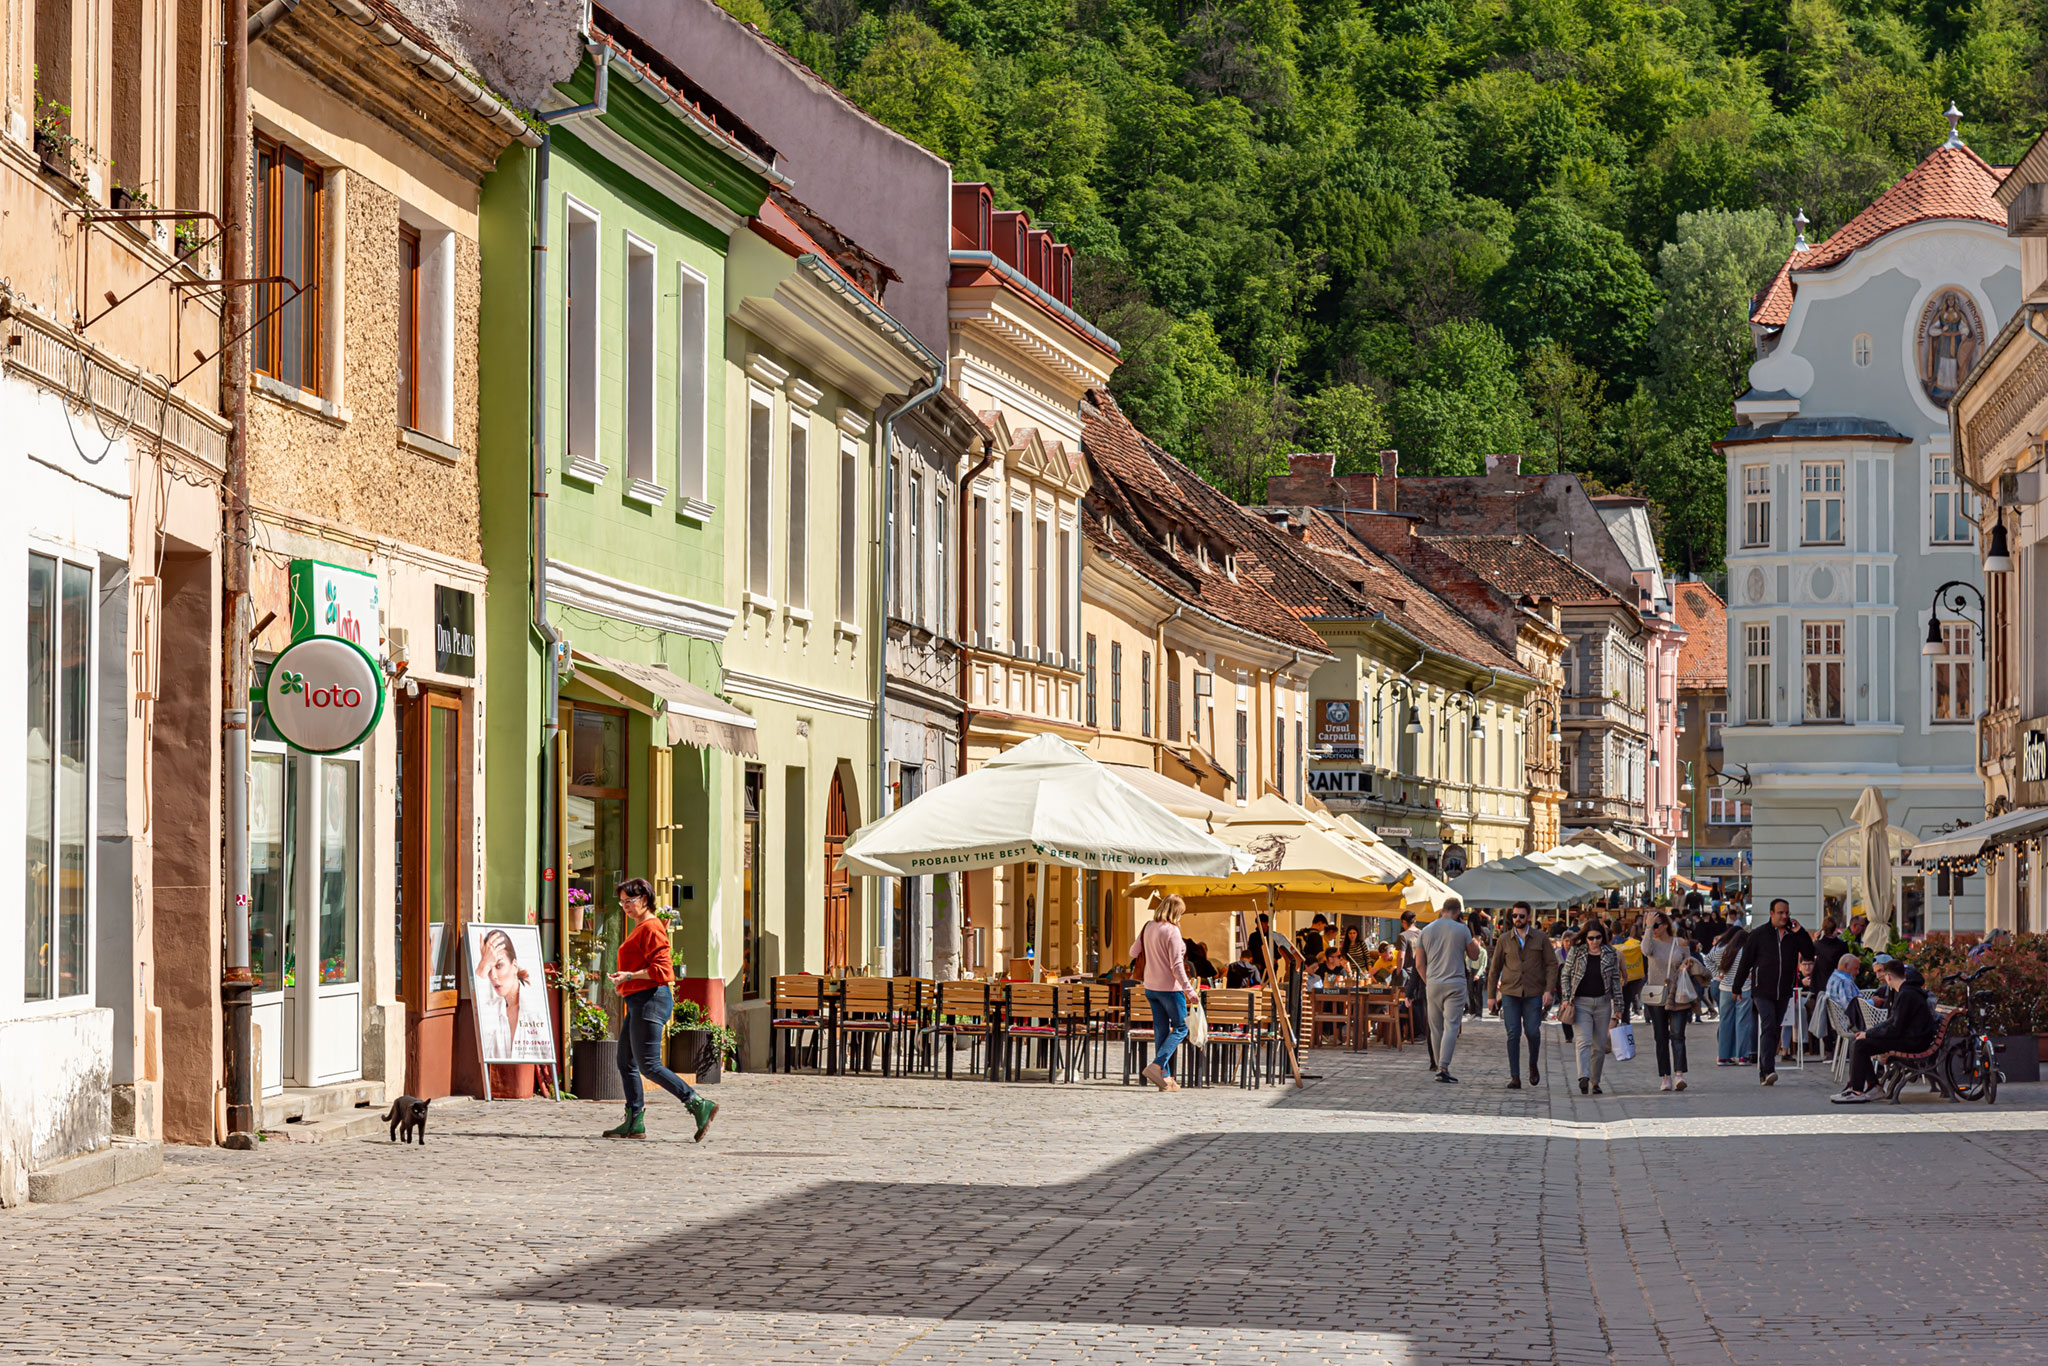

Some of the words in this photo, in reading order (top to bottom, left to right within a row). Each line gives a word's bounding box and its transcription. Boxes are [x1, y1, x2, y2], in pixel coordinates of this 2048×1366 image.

[305, 681, 363, 708] loto
[1325, 723, 1350, 732] Ursul
[1318, 732, 1356, 742] Carpatin
[2023, 729, 2047, 782] Bistro
[911, 853, 970, 868] PROBABLY
[974, 851, 995, 861] THE
[999, 847, 1026, 859] BEST
[1050, 849, 1079, 860] BEER
[1085, 852, 1096, 860] IN
[1102, 853, 1122, 863] THE
[1128, 855, 1168, 866] WORLD
[1711, 857, 1737, 866] FAR
